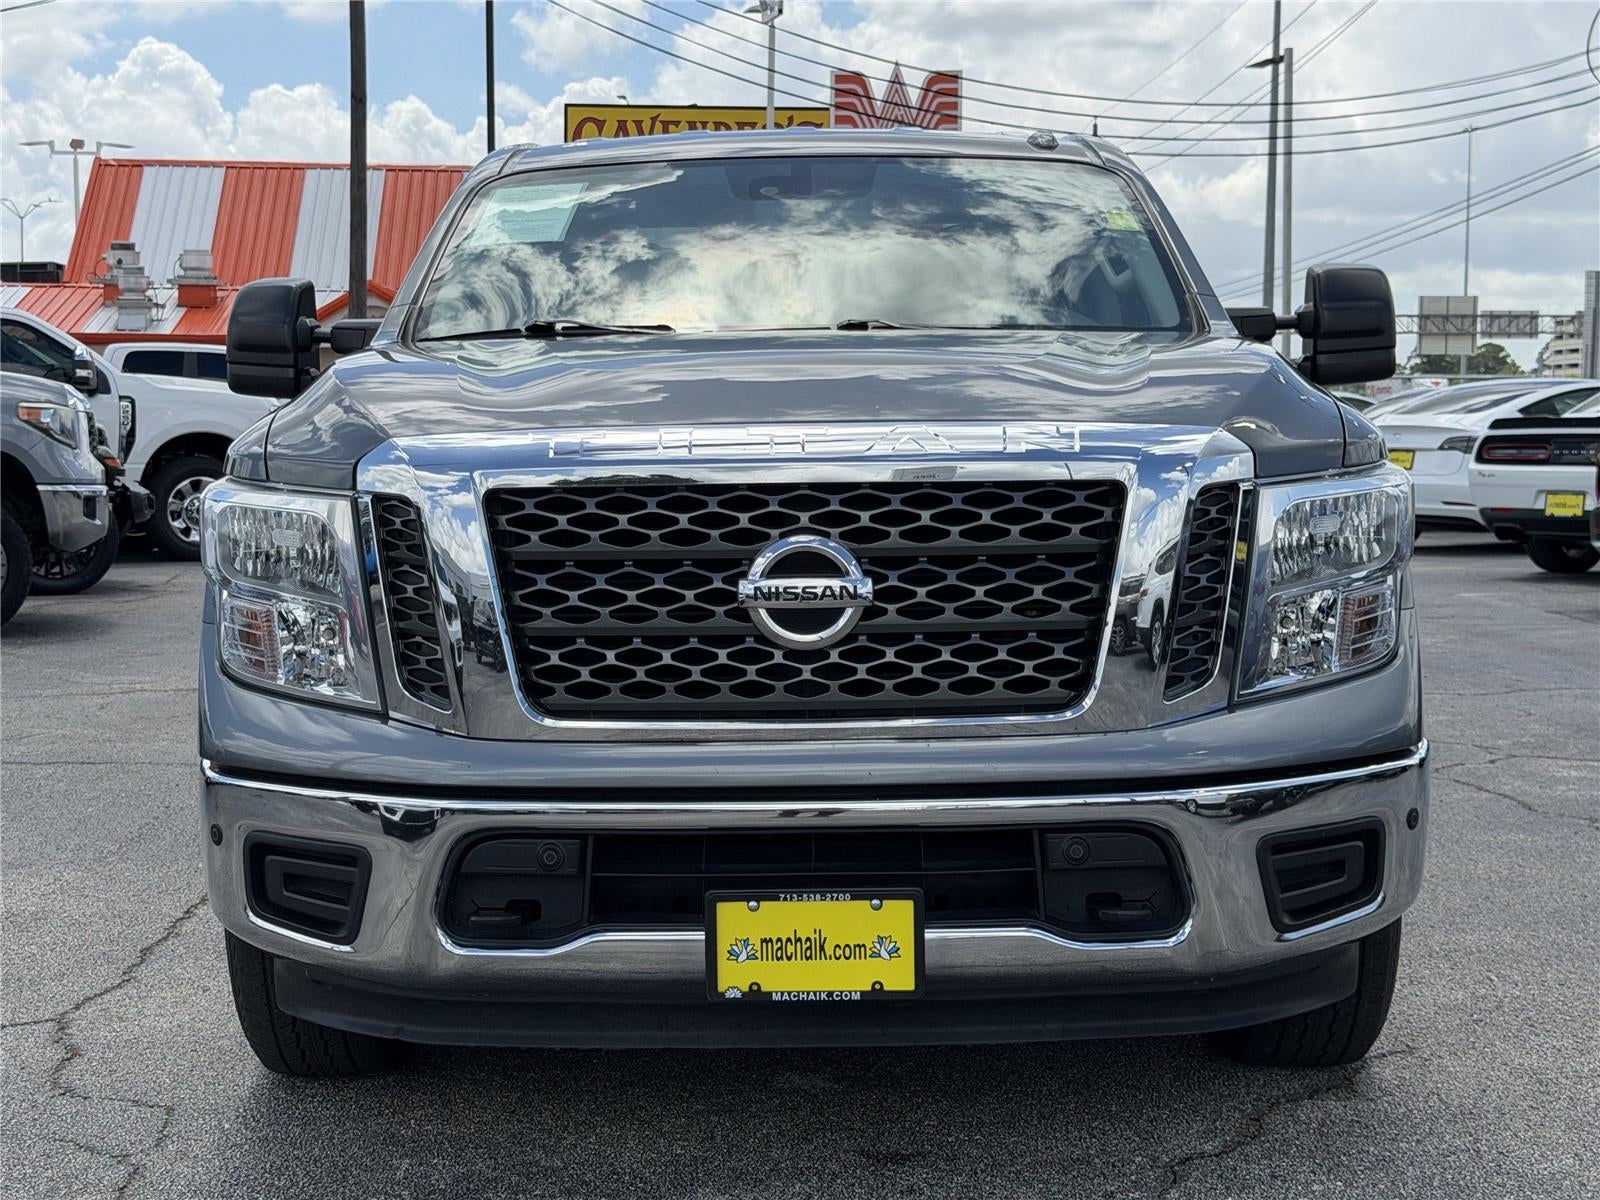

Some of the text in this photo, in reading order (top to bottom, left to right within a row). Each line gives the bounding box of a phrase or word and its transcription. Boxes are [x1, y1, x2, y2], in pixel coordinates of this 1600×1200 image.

[753, 585, 858, 602] NISSAN
[778, 893, 852, 901] 713-538-2700
[760, 929, 868, 961] machaik.com
[771, 991, 861, 1001] MACHAIK.COM
